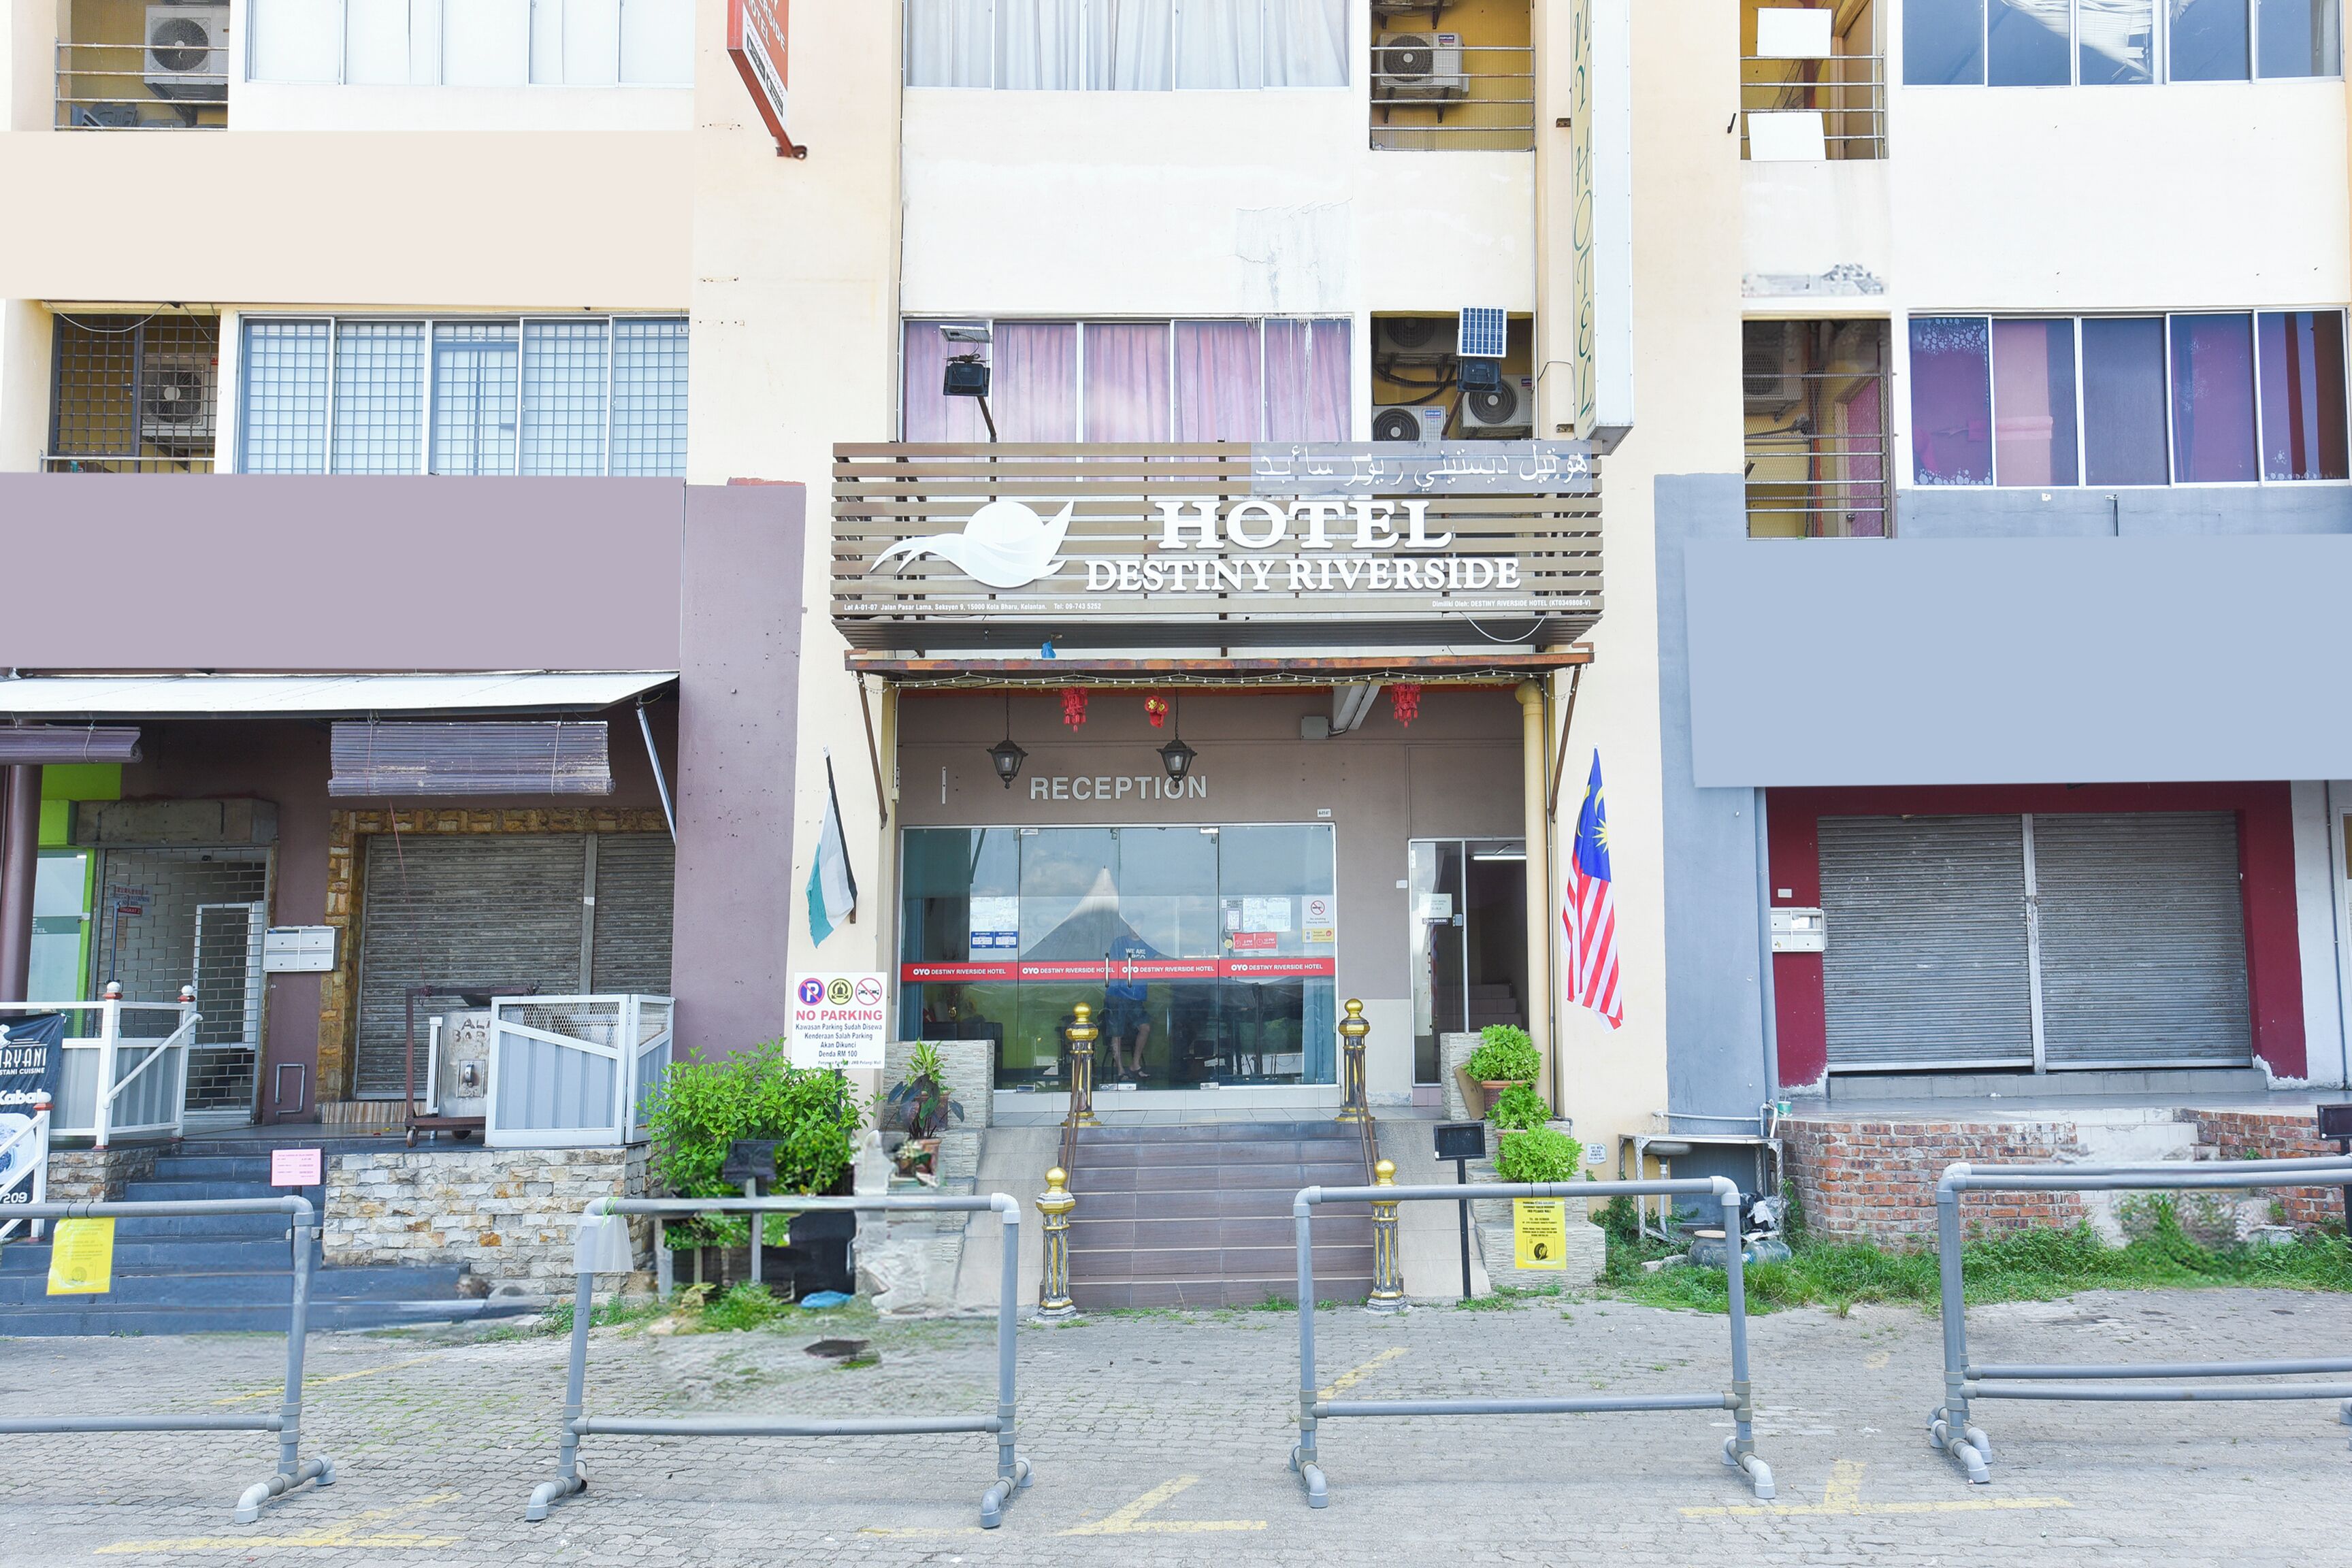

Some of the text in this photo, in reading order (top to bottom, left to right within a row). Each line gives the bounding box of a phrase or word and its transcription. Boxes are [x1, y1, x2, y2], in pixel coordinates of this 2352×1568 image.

[748, 0, 770, 47] OTEL
[760, 0, 785, 52] RSIDE
[1573, 127, 1593, 418] HOTEL
[1154, 499, 1453, 551] HOTEL
[1084, 557, 1521, 592] DESTINY RIVERSIDE
[915, 603, 933, 612] Lama,
[935, 603, 958, 612] Seksyen
[960, 603, 965, 612] 9,
[1000, 603, 1019, 612] Bharu,
[1030, 775, 1207, 800] RECEPTION
[796, 1010, 883, 1021] NO PARKING
[822, 1024, 843, 1032] Parking
[852, 1032, 873, 1041] Parking
[3, 1192, 28, 1204] 209
